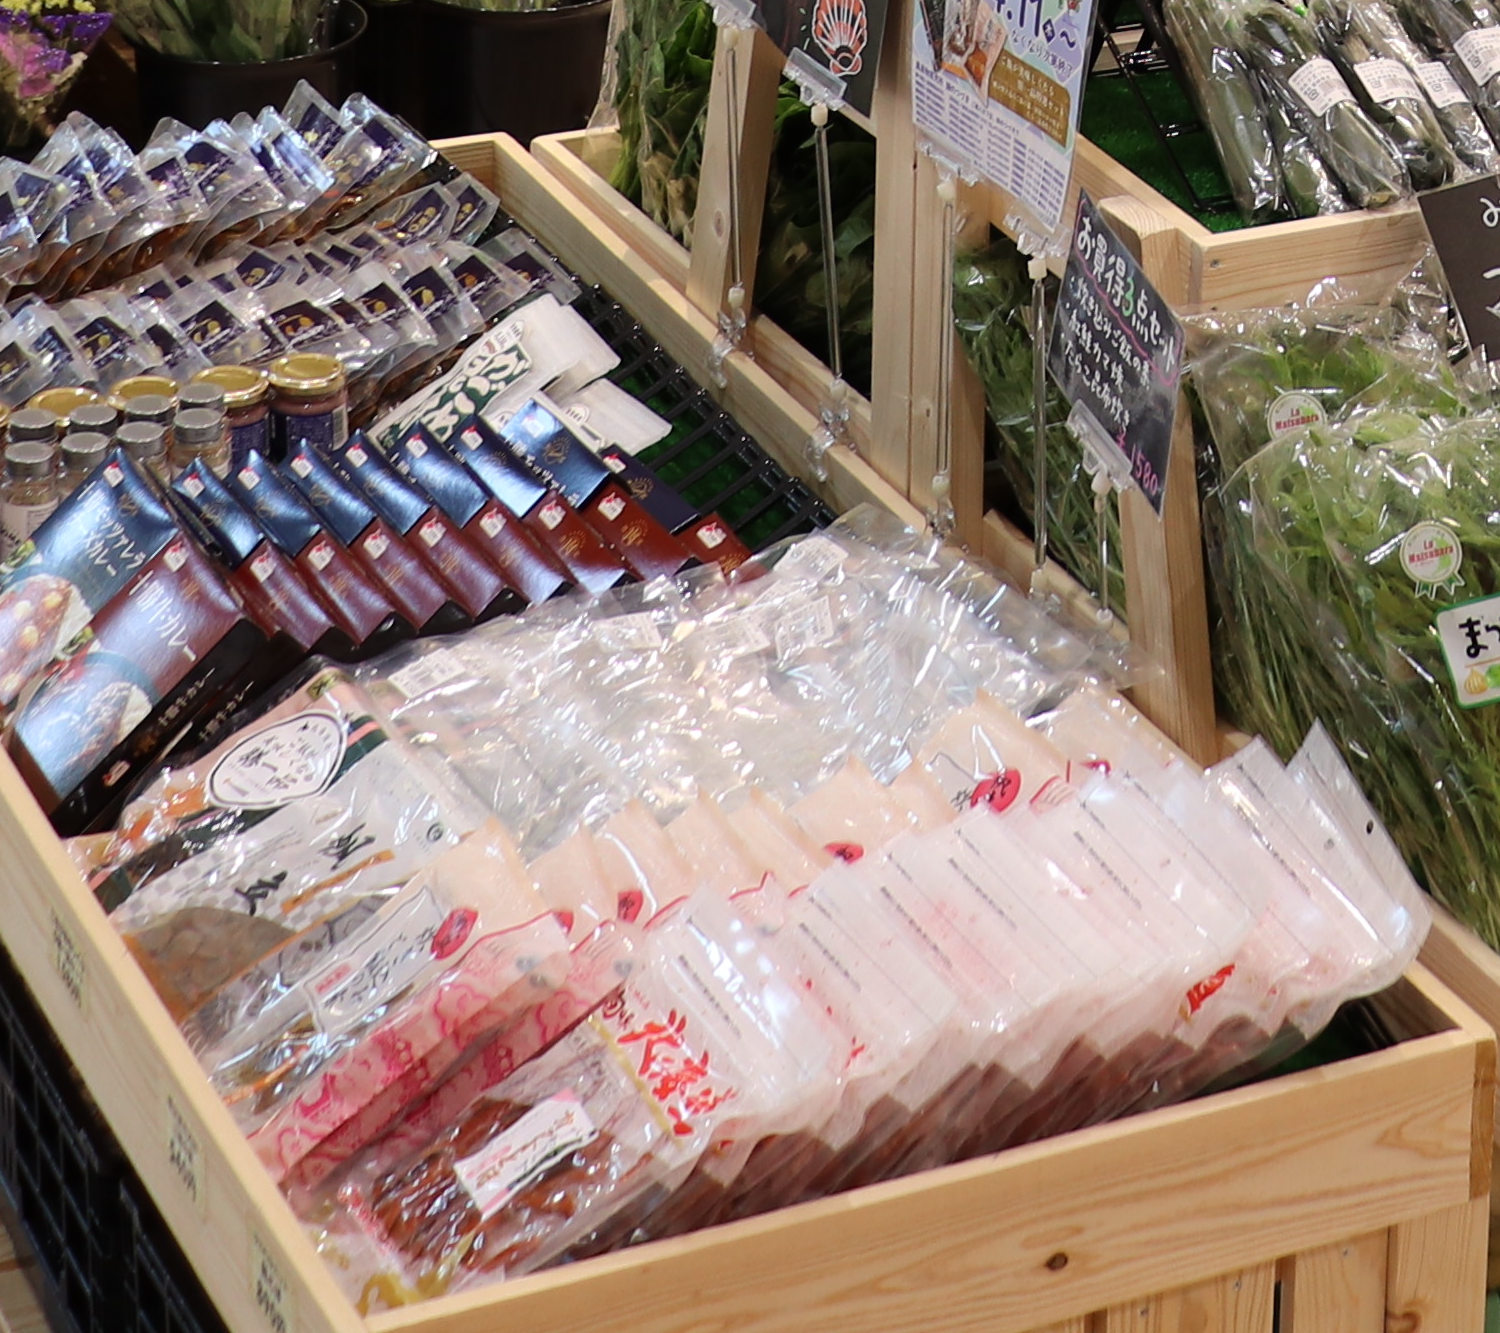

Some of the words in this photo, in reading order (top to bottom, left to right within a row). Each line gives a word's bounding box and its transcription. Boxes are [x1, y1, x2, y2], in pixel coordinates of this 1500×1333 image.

[1078, 215, 1175, 374] お買得3点セット
